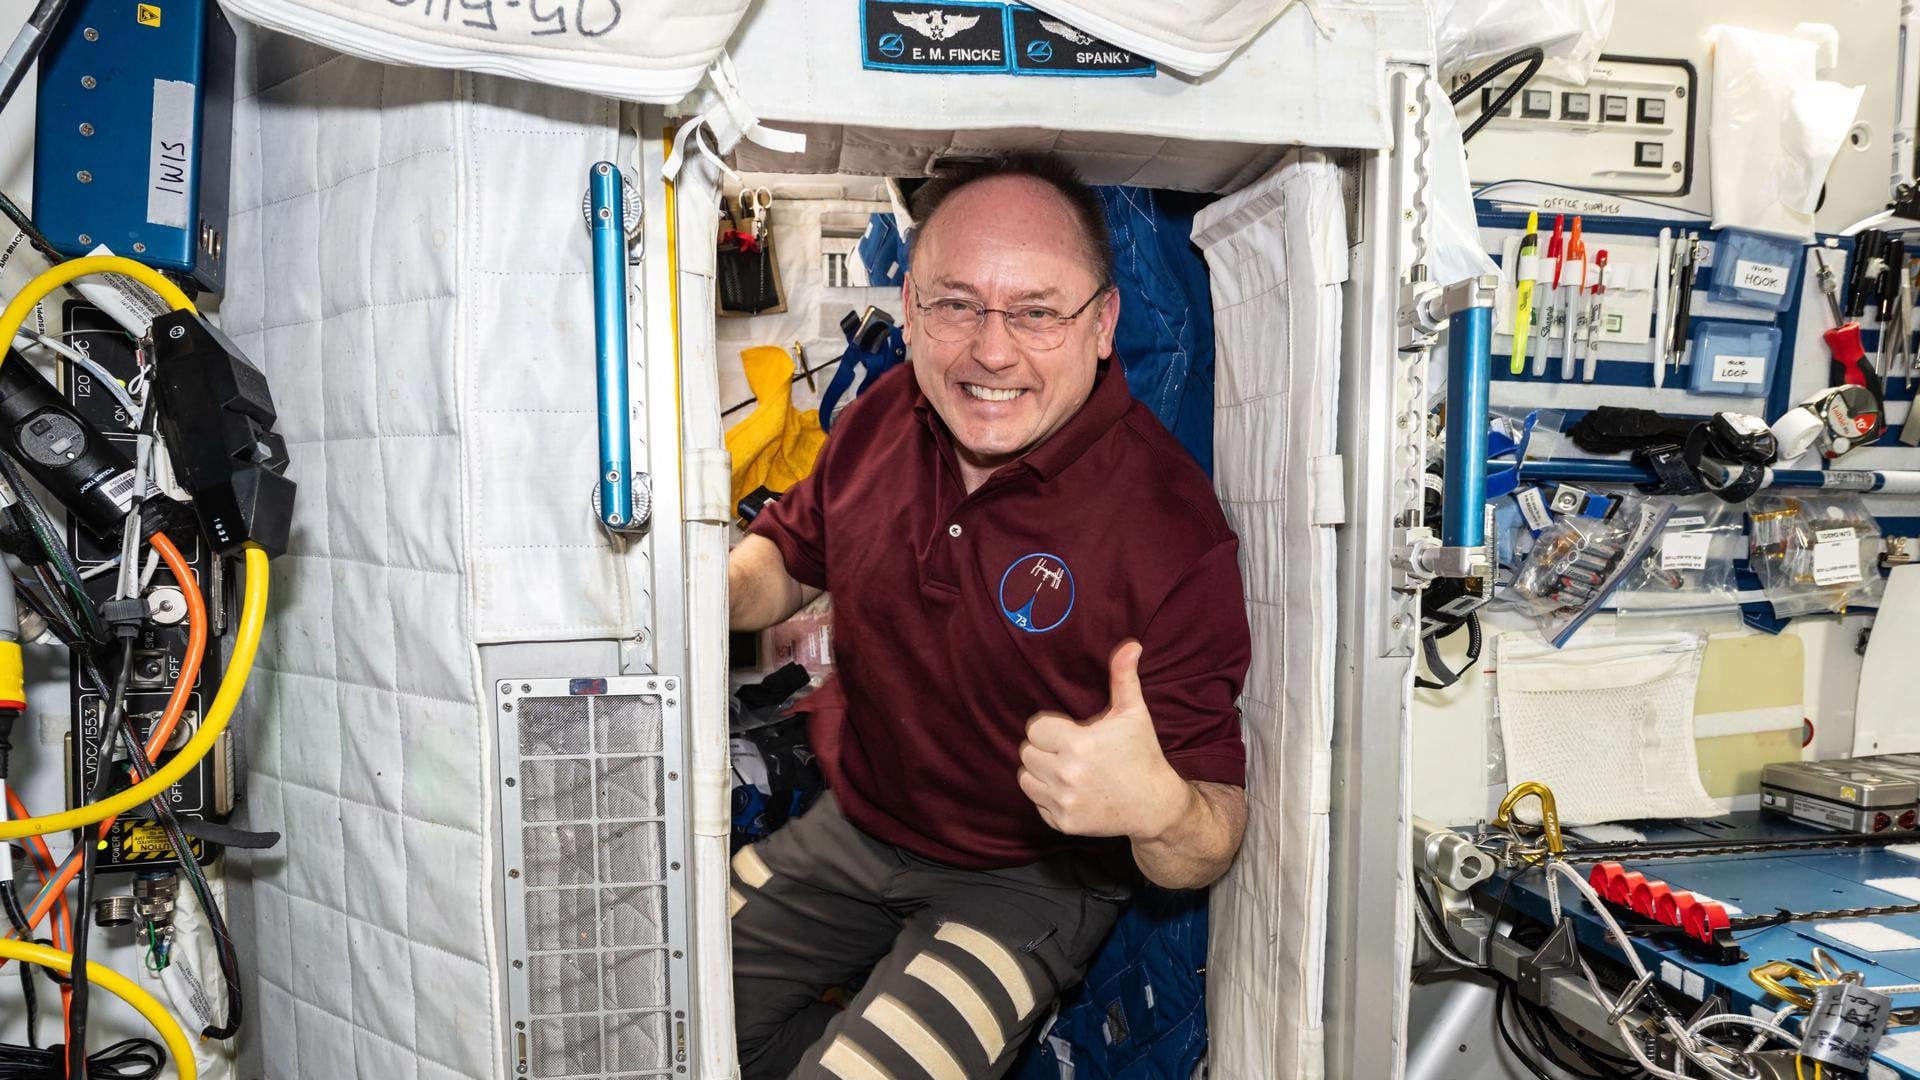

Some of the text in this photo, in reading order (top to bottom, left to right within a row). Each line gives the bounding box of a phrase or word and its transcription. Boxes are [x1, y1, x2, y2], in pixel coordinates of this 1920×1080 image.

[387, 0, 621, 37] 05-5
[912, 48, 1001, 61] E. M. FINCKE
[1076, 51, 1131, 63] SPANKY
[1544, 199, 1623, 213] OFFICE SUPPLIES
[1744, 274, 1778, 288] HOOK
[1721, 369, 1748, 377] LOOP
[78, 374, 91, 397] 120
[114, 406, 126, 421] ON
[1015, 613, 1028, 627] 73
[145, 631, 155, 649] SW2
[169, 656, 181, 679] OFF
[171, 780, 183, 803] OFF
[112, 821, 121, 863] POWER ON
